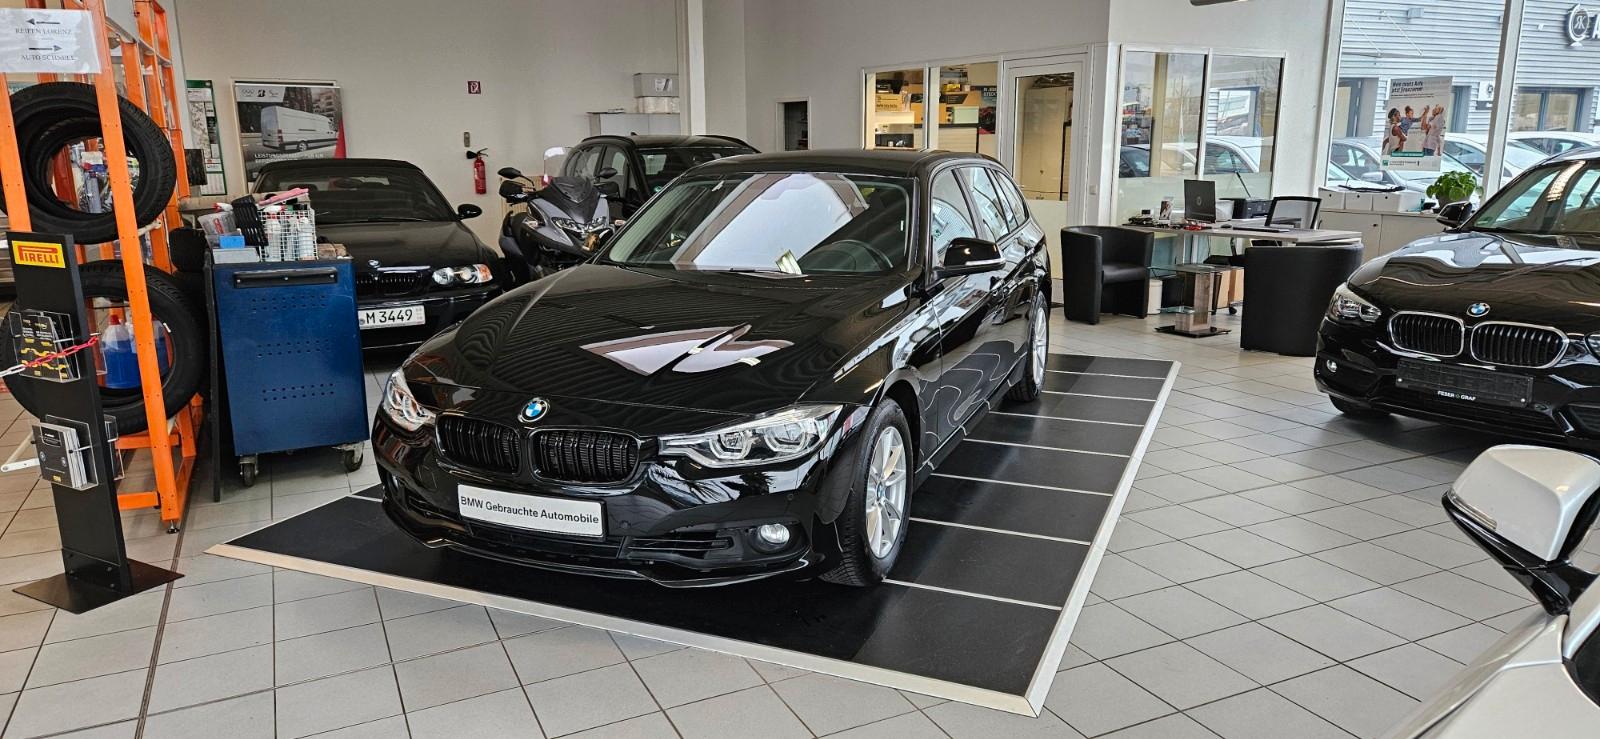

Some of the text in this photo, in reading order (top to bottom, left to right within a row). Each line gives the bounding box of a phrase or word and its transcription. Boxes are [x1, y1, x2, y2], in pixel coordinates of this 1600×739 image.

[17, 245, 59, 264] PIRELLI
[366, 309, 413, 324] M 3449
[1437, 390, 1455, 398] FESER
[460, 496, 599, 524] BMW Gebrauchte Automobile
